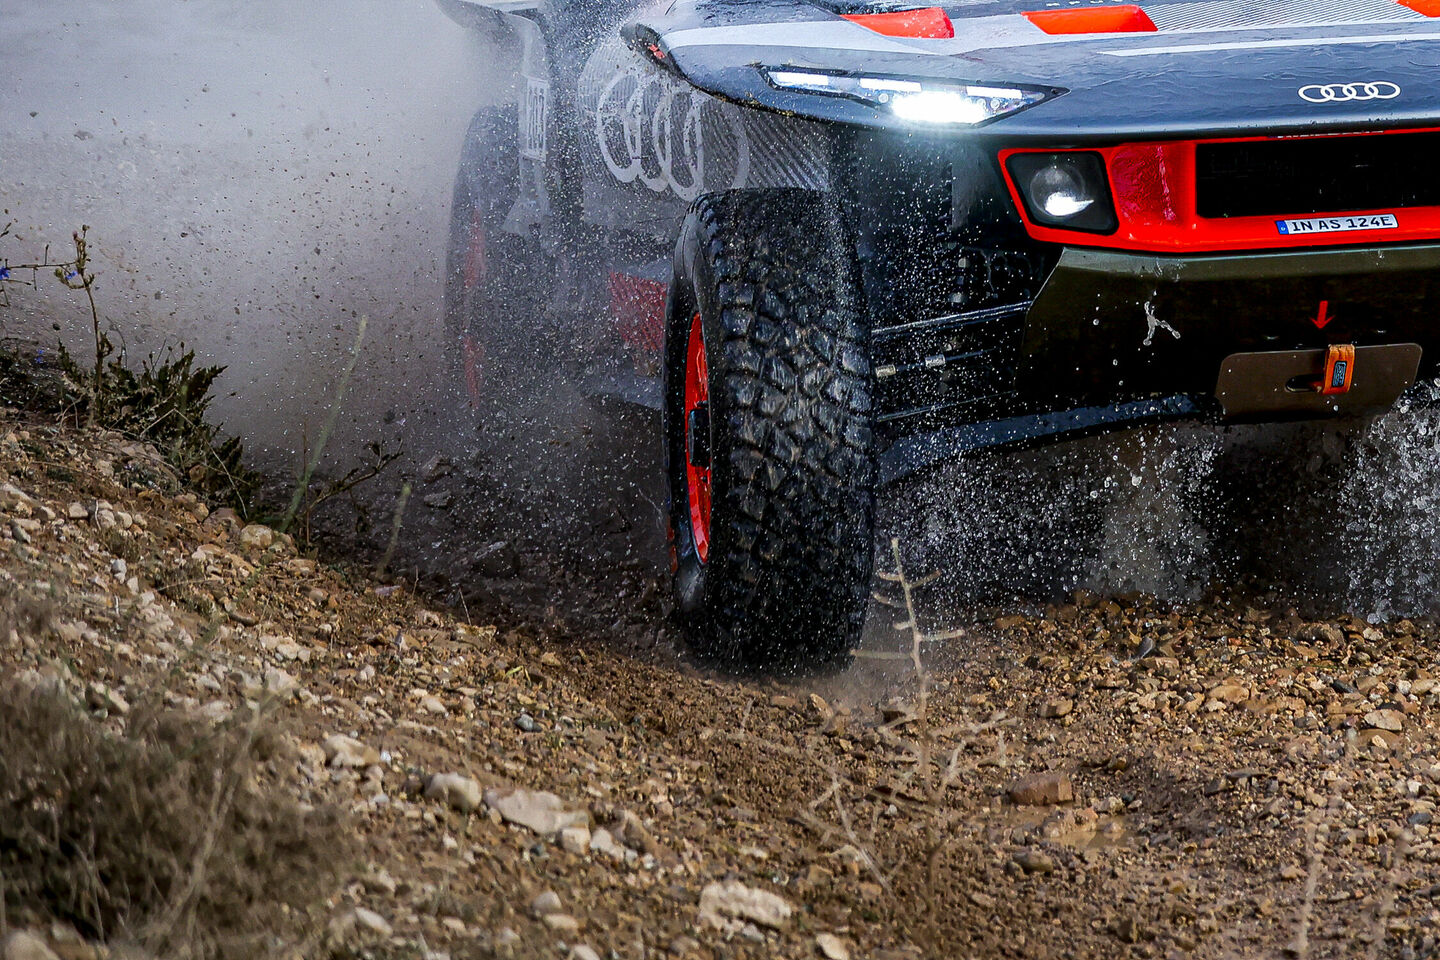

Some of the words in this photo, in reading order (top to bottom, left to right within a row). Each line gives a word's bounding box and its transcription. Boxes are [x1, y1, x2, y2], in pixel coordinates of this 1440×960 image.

[1292, 221, 1313, 232] IN
[1318, 219, 1341, 230] AS
[1346, 216, 1393, 228] 124E
